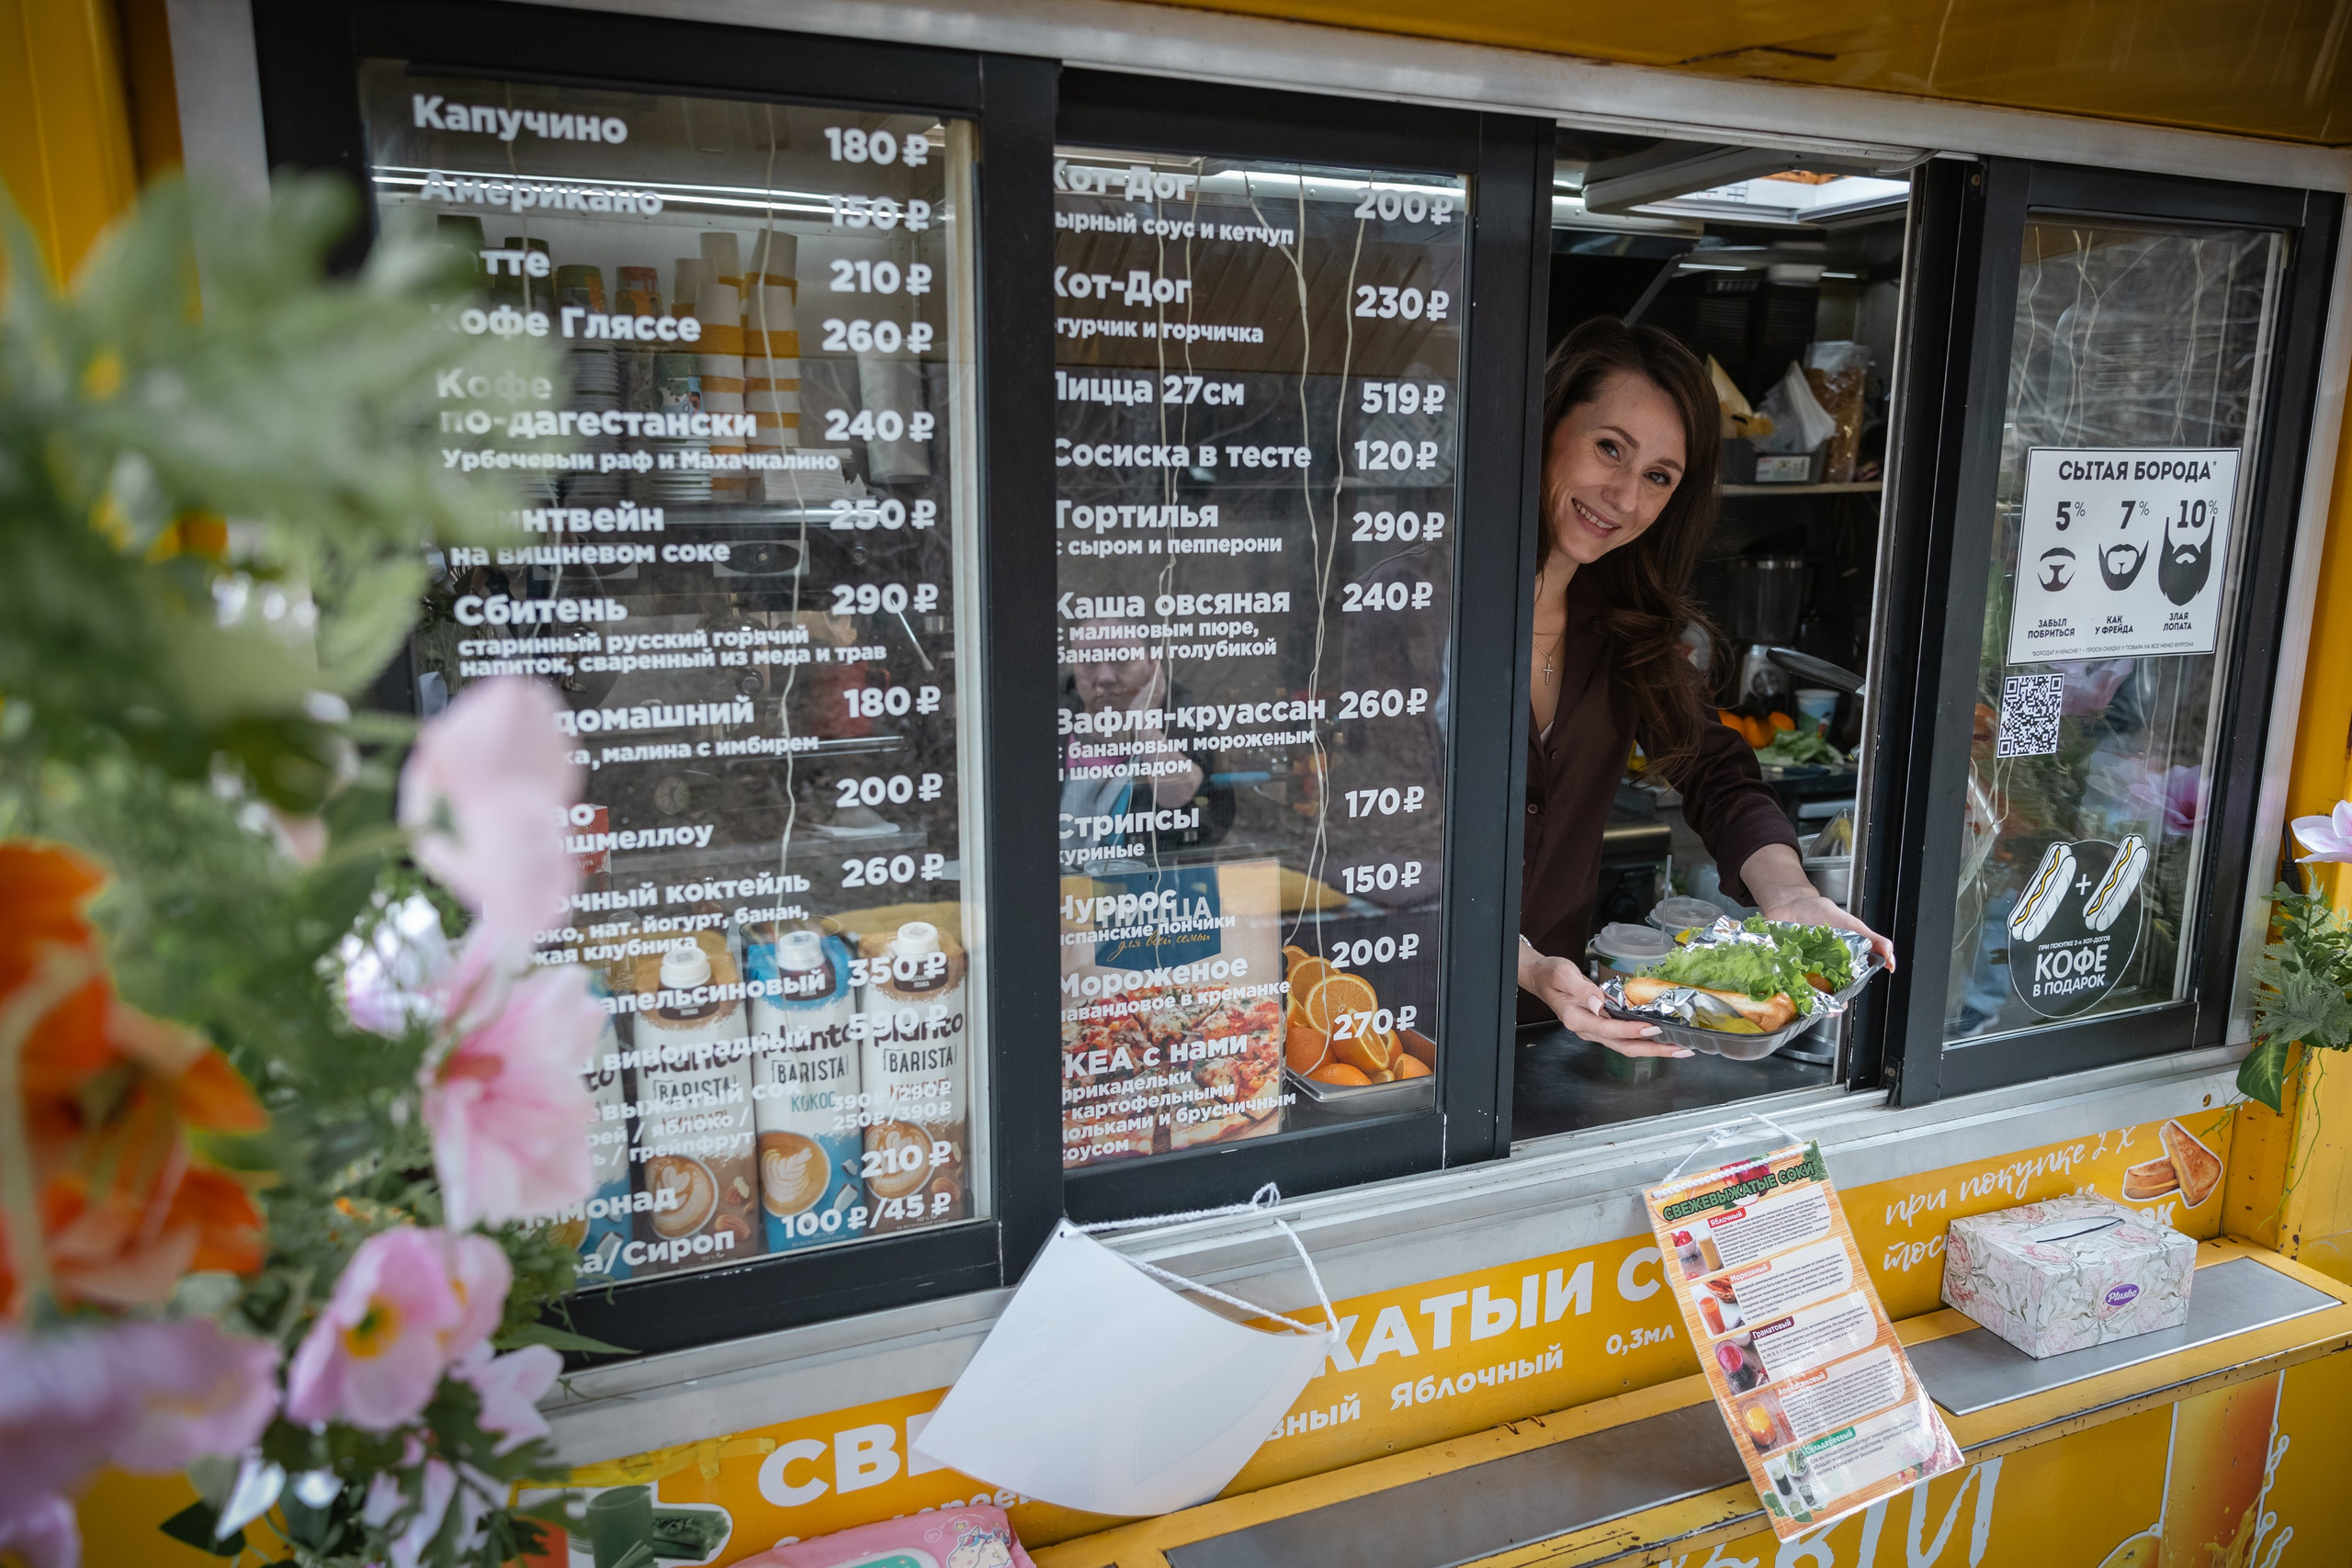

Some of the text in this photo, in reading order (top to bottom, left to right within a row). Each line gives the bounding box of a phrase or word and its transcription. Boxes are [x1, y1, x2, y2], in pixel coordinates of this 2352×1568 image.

[413, 94, 628, 144] Капучино
[420, 171, 664, 216] Американо
[1056, 211, 1295, 247] ырный соус и кетчуп
[560, 306, 702, 343] Гляссе
[1054, 317, 1264, 344] гурчик и горчичка
[1162, 375, 1245, 406] 27см
[440, 409, 758, 439] по-дагестански
[599, 449, 841, 473] раф и Махачкалино
[1056, 438, 1312, 468] Сосиска в тесте
[2058, 460, 2129, 480] СЫТАЯ
[2055, 500, 2086, 532] 5%
[2120, 500, 2150, 530] 7%
[2177, 499, 2219, 529] 10%
[450, 542, 731, 566] на вишневом соке
[1068, 538, 1145, 558] сыром
[1148, 539, 1162, 555] и
[1167, 536, 1283, 558] пепперони
[454, 594, 628, 626] Сбитень
[1154, 591, 1291, 618] овсяная
[2168, 612, 2189, 622] ЗЛАЯ
[1069, 622, 1194, 642] малиновым
[1198, 621, 1260, 642] пюре,
[2027, 626, 2075, 639] ПОБРИТЬСЯ
[2038, 617, 2067, 629] ЗАБЫЛ
[2102, 622, 2134, 636] ФРЕЙДА
[2106, 615, 2123, 626] КАК
[2162, 621, 2192, 632] ЛОПАТА
[458, 625, 809, 657] старинный русский горячий
[1149, 645, 1164, 661] и
[1168, 637, 1277, 661] голубикой
[459, 642, 888, 677] напиток, сваренный из меда и трав
[602, 743, 692, 763] малина
[696, 742, 712, 758] с
[716, 735, 820, 757] имбирем
[1069, 736, 1189, 762] банановым
[1193, 729, 1316, 752] мороженым
[1069, 758, 1193, 783] шоколадом
[1059, 807, 1200, 843] Стрипсы
[666, 873, 810, 906] коктейль
[642, 911, 729, 938] йогурт,
[1158, 913, 1236, 935] пончики
[584, 935, 697, 961] клубника
[2038, 943, 2050, 952] ПРИ
[2050, 941, 2074, 950] ПОКУПКЕ
[2083, 934, 2111, 945] ХОТ-ДОГОВ
[2035, 944, 2109, 981] КОФЕ
[1061, 956, 1249, 999] Мороженое
[2032, 973, 2106, 998] В ПОДАРОК
[1181, 993, 1193, 1007] в
[1197, 979, 1291, 1006] креманке
[603, 1029, 812, 1071] виноградный
[889, 1046, 954, 1073] BARISTA
[1142, 1032, 1249, 1067] с нами
[777, 1056, 845, 1084] BARISTA
[752, 1080, 802, 1101] сок
[1071, 1082, 1236, 1122] картофельными
[1159, 1091, 1296, 1126] и брусничным
[628, 1131, 754, 1163] грейпфрут
[1663, 1161, 1815, 1221] СВЕЖЕВЫЖАТЫЕ СОКИ
[1884, 1189, 1947, 1228] при
[1960, 1145, 2086, 1201] покупке
[1710, 1211, 1743, 1227] Яблочный
[1729, 1263, 1769, 1282] Морковный
[1752, 1318, 1792, 1339] Гранатовый
[1389, 1343, 1564, 1412] Яблочный
